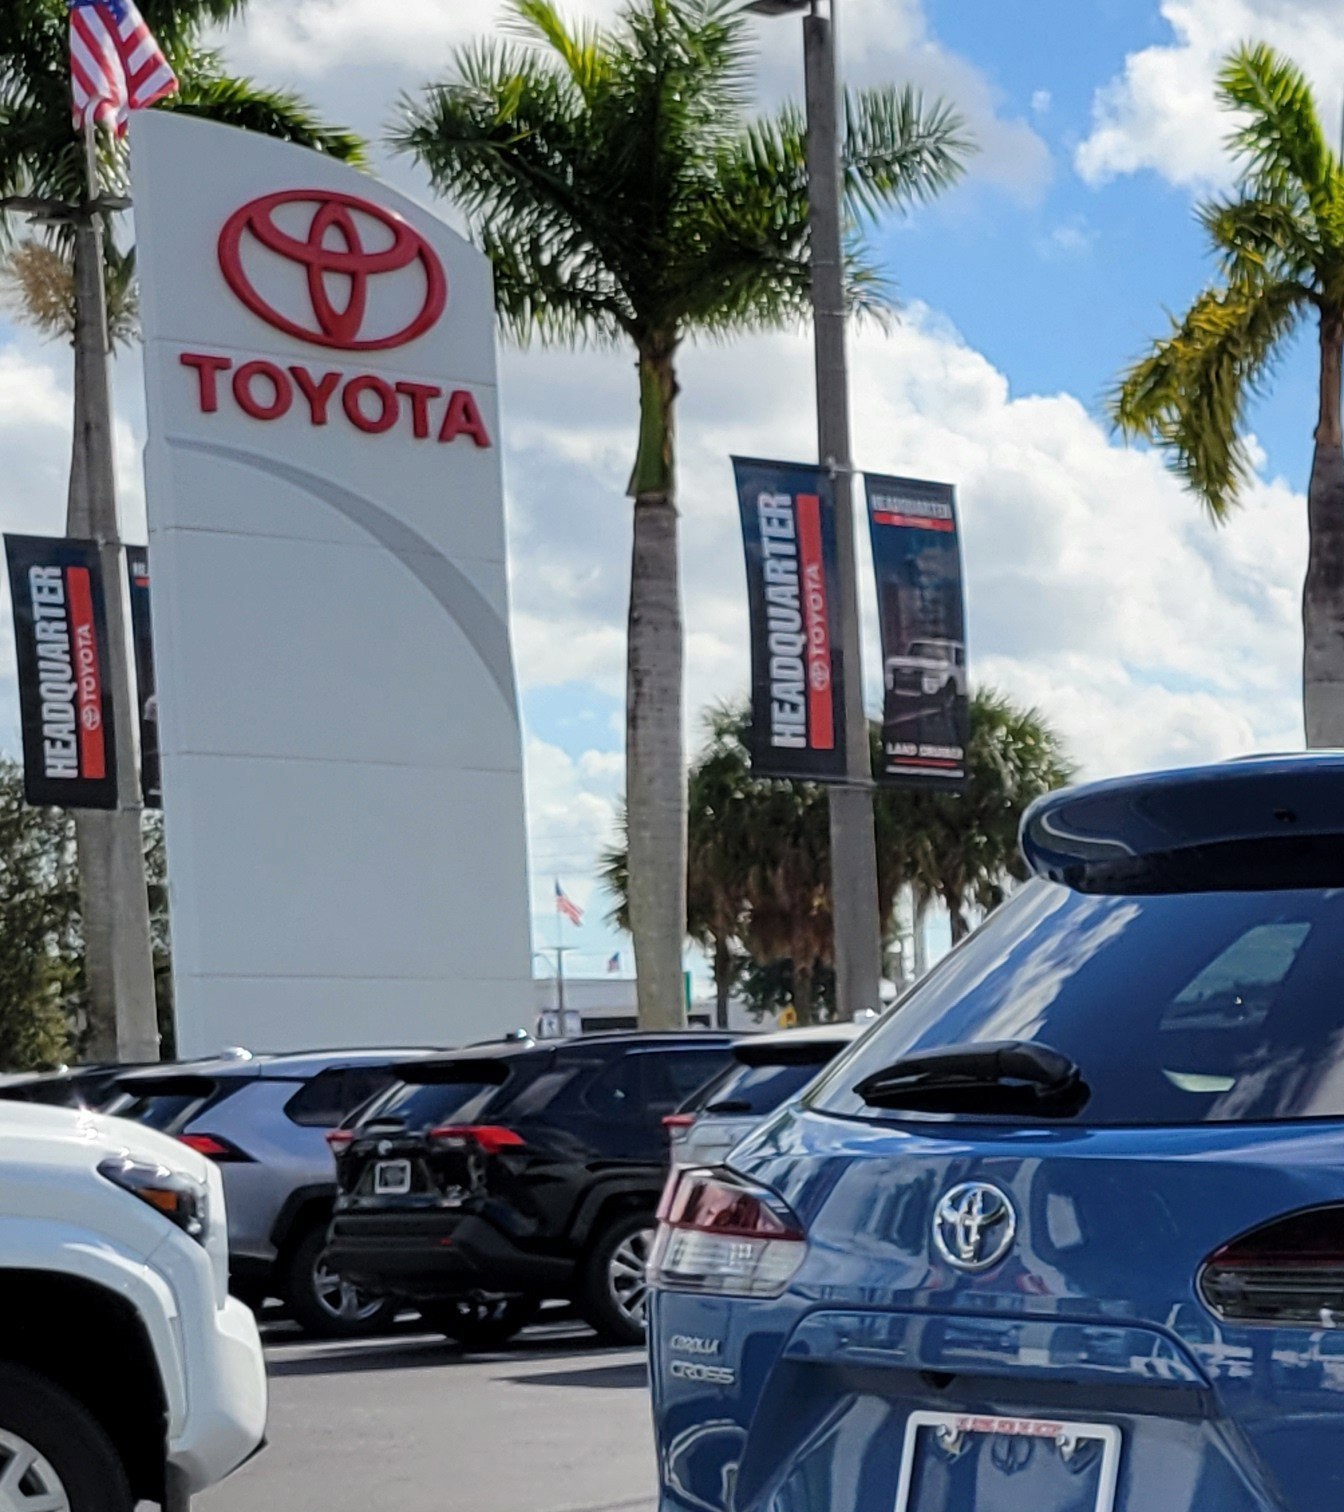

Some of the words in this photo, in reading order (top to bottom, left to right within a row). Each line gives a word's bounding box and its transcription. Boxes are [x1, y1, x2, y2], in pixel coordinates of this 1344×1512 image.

[180, 353, 491, 447] TOYOTA
[757, 492, 807, 748] HEADQUARTER
[805, 565, 827, 654] TOYOTA
[29, 565, 79, 778] HEADQUARTER
[77, 625, 98, 702] TOYOTA
[672, 1360, 735, 1384] CROSS
